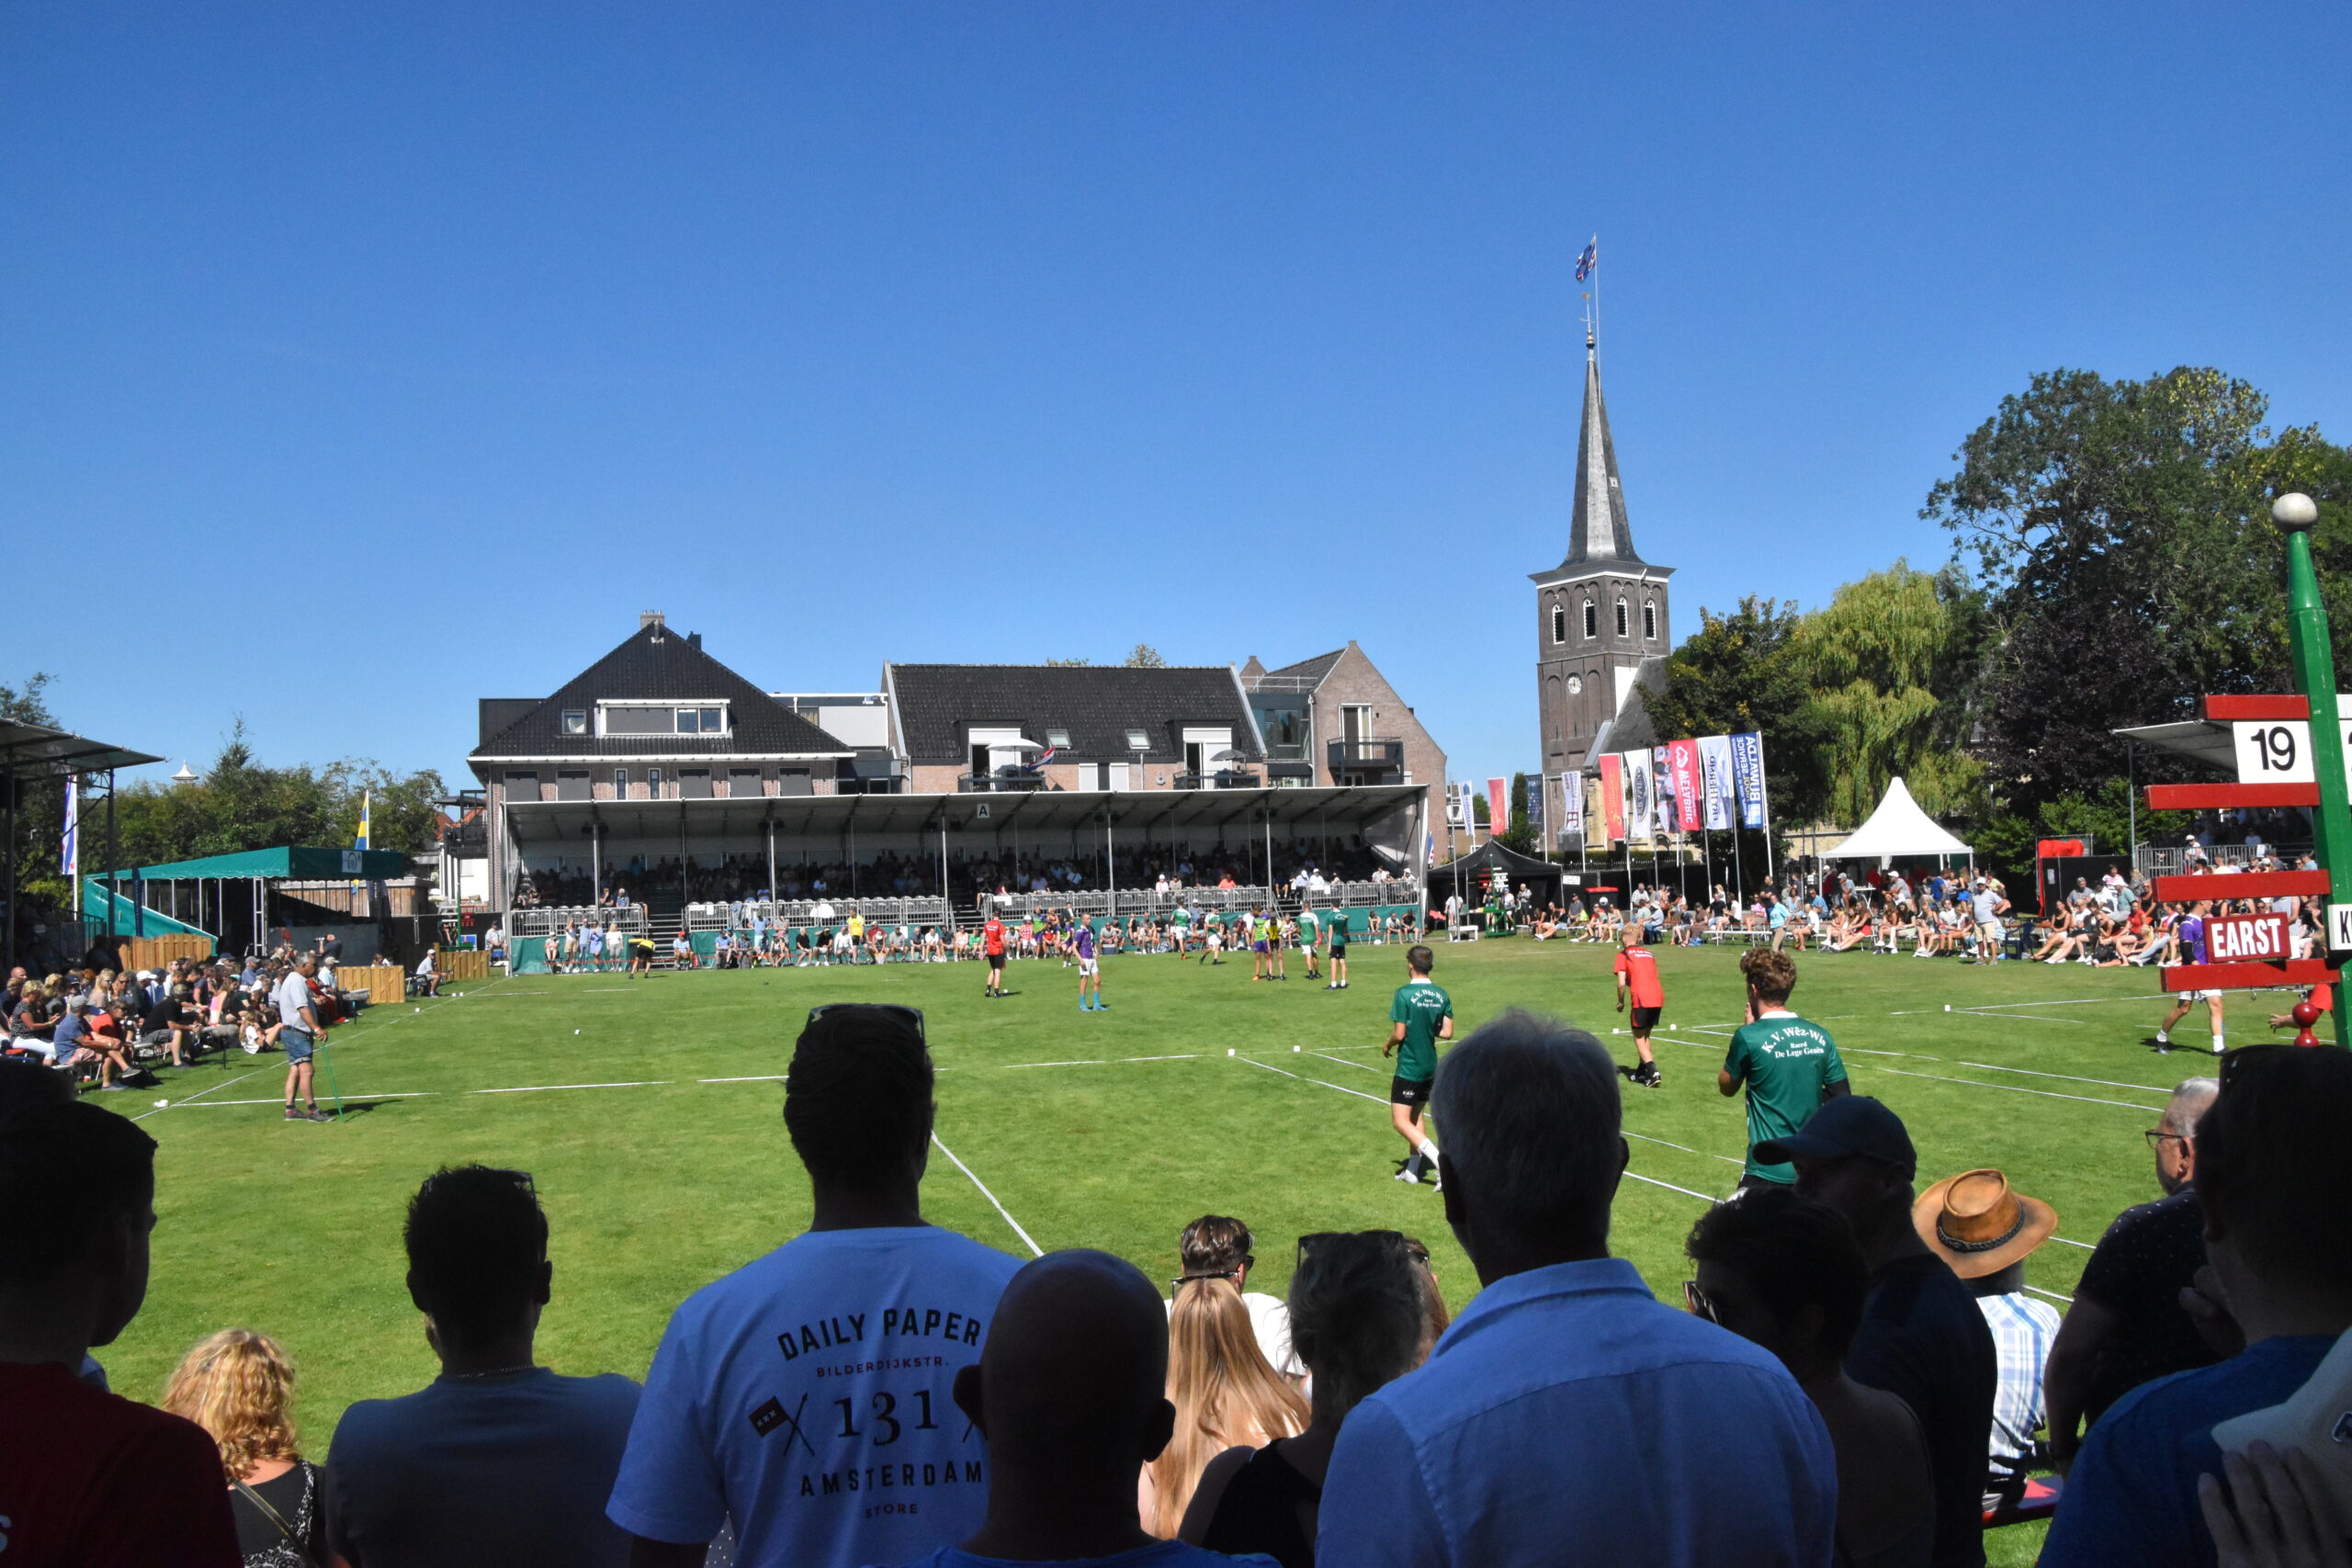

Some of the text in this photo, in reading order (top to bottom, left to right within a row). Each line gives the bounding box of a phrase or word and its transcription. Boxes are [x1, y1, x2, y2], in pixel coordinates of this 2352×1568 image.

[2250, 726, 2296, 772] 19
[978, 806, 988, 817] A
[2211, 918, 2282, 959] EARST
[2339, 910, 2352, 944] K
[1786, 1049, 1803, 1057] Lege
[777, 1307, 981, 1361] DAILY PAPER
[817, 1356, 949, 1378] BILDERDIJKSTR.
[833, 1389, 939, 1447] 131
[800, 1460, 982, 1496] AMSTERDAM
[865, 1503, 918, 1518] STORE
